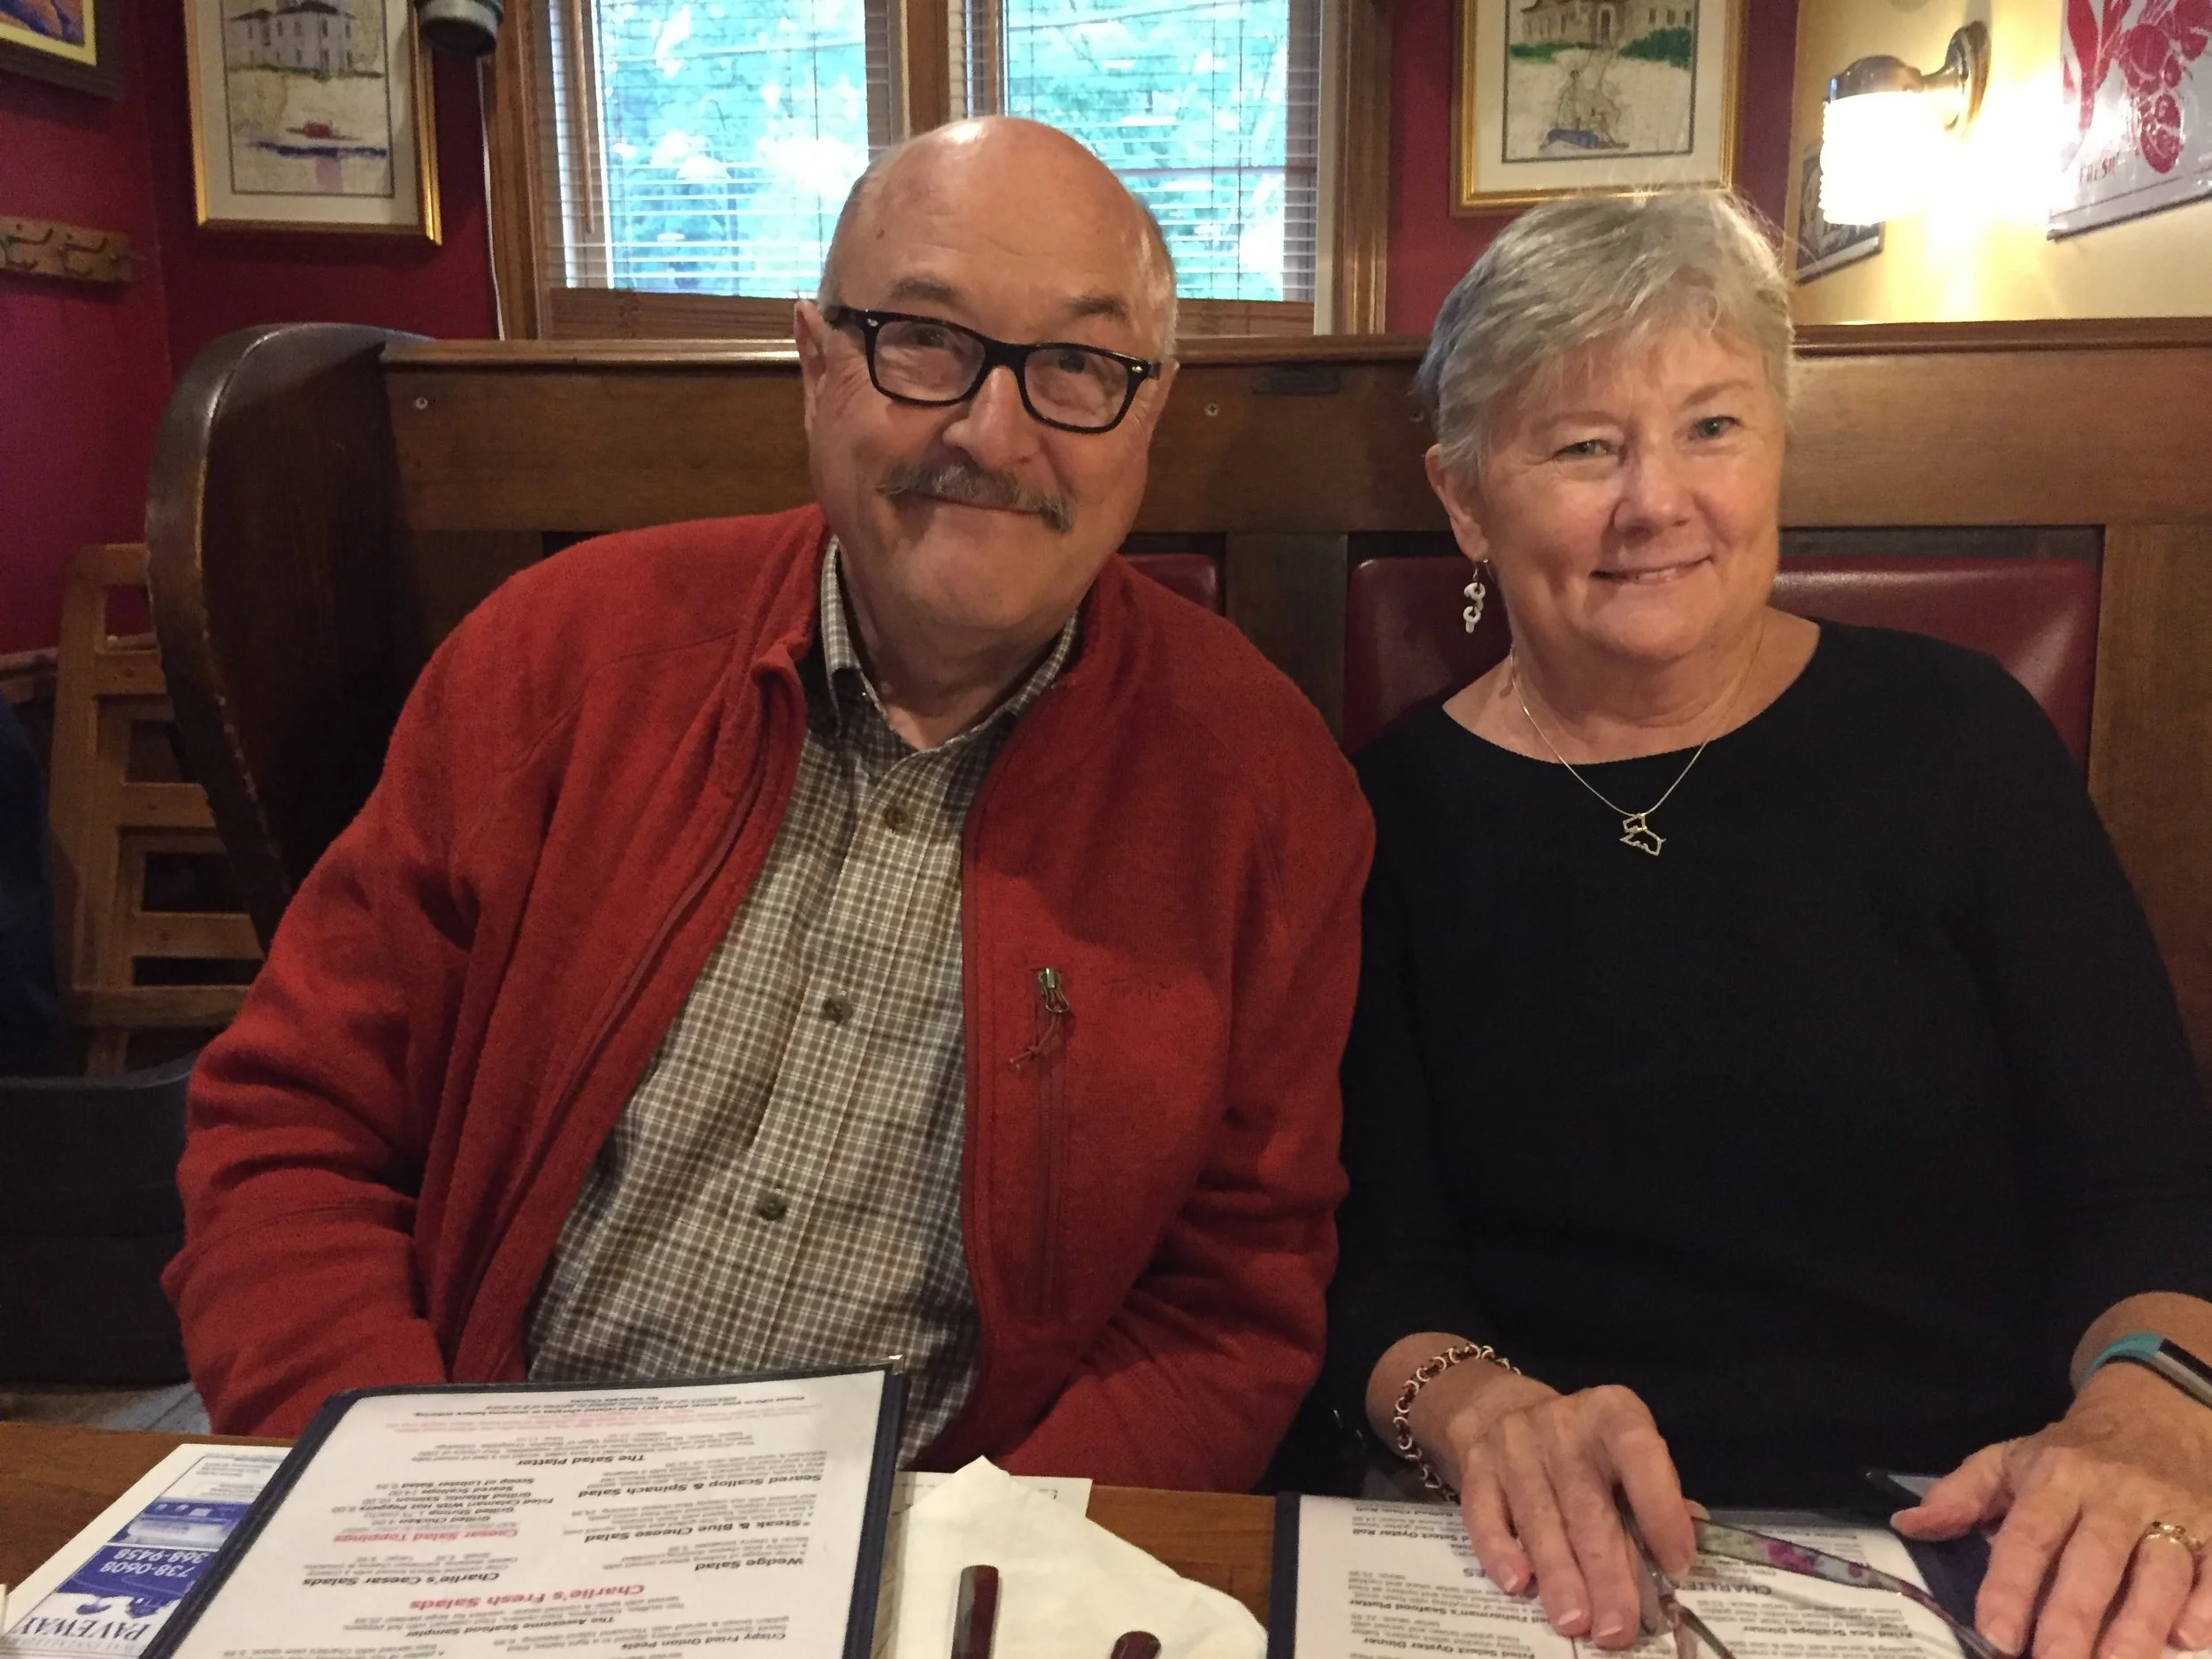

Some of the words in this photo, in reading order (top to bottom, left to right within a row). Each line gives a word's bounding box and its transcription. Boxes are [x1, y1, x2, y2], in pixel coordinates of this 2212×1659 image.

[516, 1458, 567, 1467] Platter
[572, 1455, 614, 1465] Salad
[708, 1475, 764, 1487] Scallop
[768, 1474, 822, 1484] Seared
[577, 1488, 622, 1499] Salad
[626, 1482, 687, 1496] Spinach
[634, 1526, 694, 1538] Cheese
[696, 1522, 733, 1533] Blue
[333, 1532, 407, 1543] Toppings
[411, 1531, 459, 1541] Salad
[464, 1528, 518, 1539] Caesar
[584, 1532, 630, 1543] Salad
[1421, 1532, 1458, 1541] Select
[113, 1548, 210, 1564] 368-9458
[694, 1560, 741, 1571] Salad
[745, 1556, 804, 1568] Wedge
[99, 1561, 196, 1578] 738-0608
[303, 1577, 360, 1587] Salads
[365, 1577, 422, 1586] Caesar
[426, 1572, 500, 1586] Charlie's
[553, 1585, 645, 1601] Charlie's
[408, 1597, 481, 1611] Salads
[486, 1593, 546, 1607] Fresh
[1349, 1599, 1391, 1609] Platter
[1394, 1603, 1447, 1615] Seafood
[1450, 1609, 1527, 1623] Fisherman's
[11, 1617, 150, 1642] PAVEWAY
[464, 1624, 518, 1634] Seafood
[522, 1618, 587, 1630] Awesome
[404, 1627, 461, 1638] Sampler
[1790, 1627, 1847, 1637] Scallops
[705, 1635, 739, 1644] Fried
[1363, 1639, 1407, 1649] Dinner
[1411, 1644, 1454, 1654] Oyster
[1457, 1647, 1497, 1657] Select
